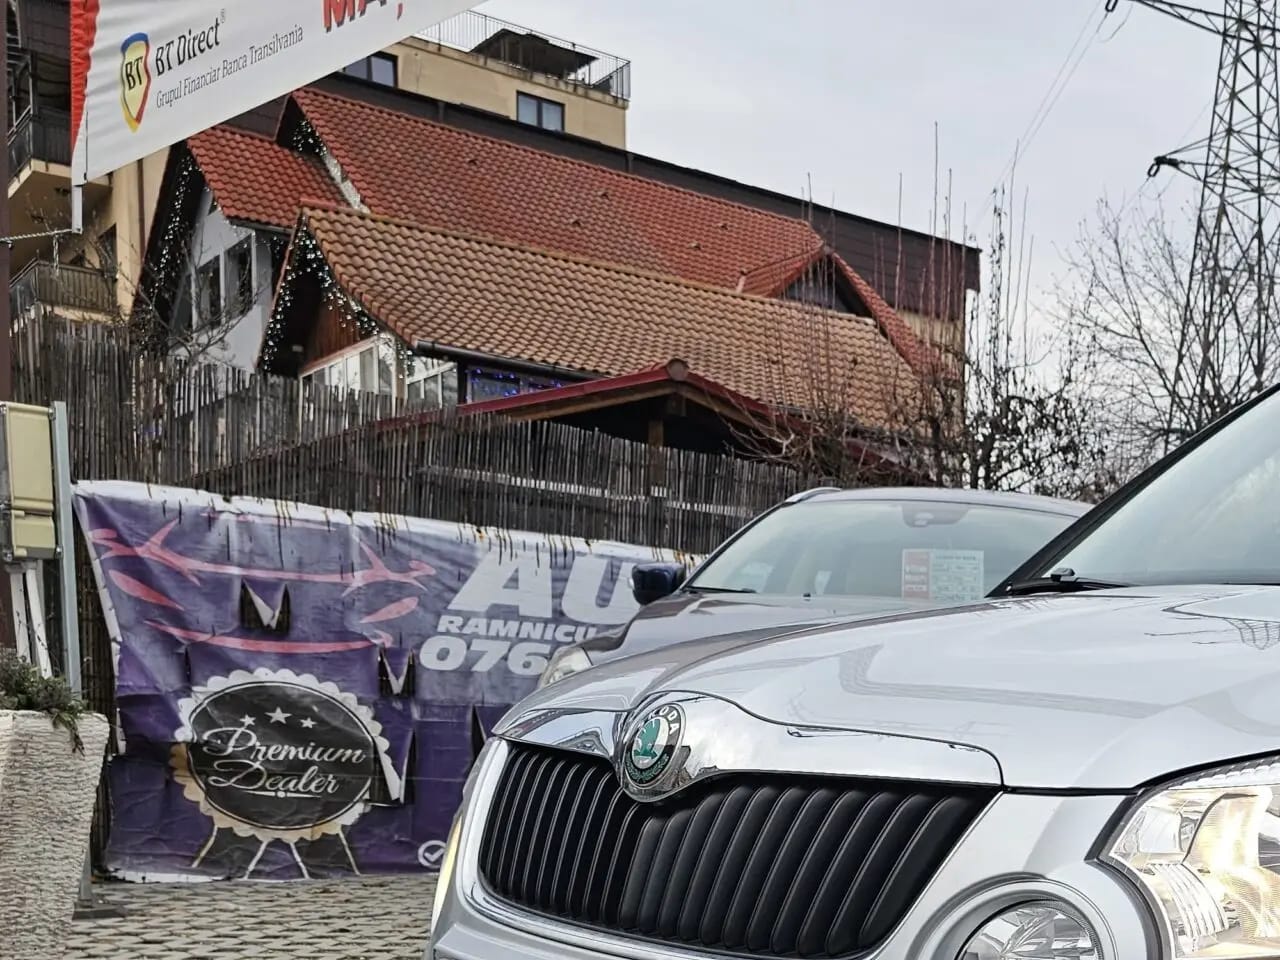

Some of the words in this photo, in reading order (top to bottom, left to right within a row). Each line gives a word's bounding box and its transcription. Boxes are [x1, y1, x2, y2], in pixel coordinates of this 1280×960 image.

[125, 56, 143, 91] BT
[155, 40, 174, 76] BT
[156, 80, 182, 108] Grupul
[184, 67, 221, 97] Financiar
[222, 54, 248, 79] Banca
[248, 24, 304, 66] Transilvania
[202, 727, 366, 764] Premium
[207, 759, 340, 795] Dealer
